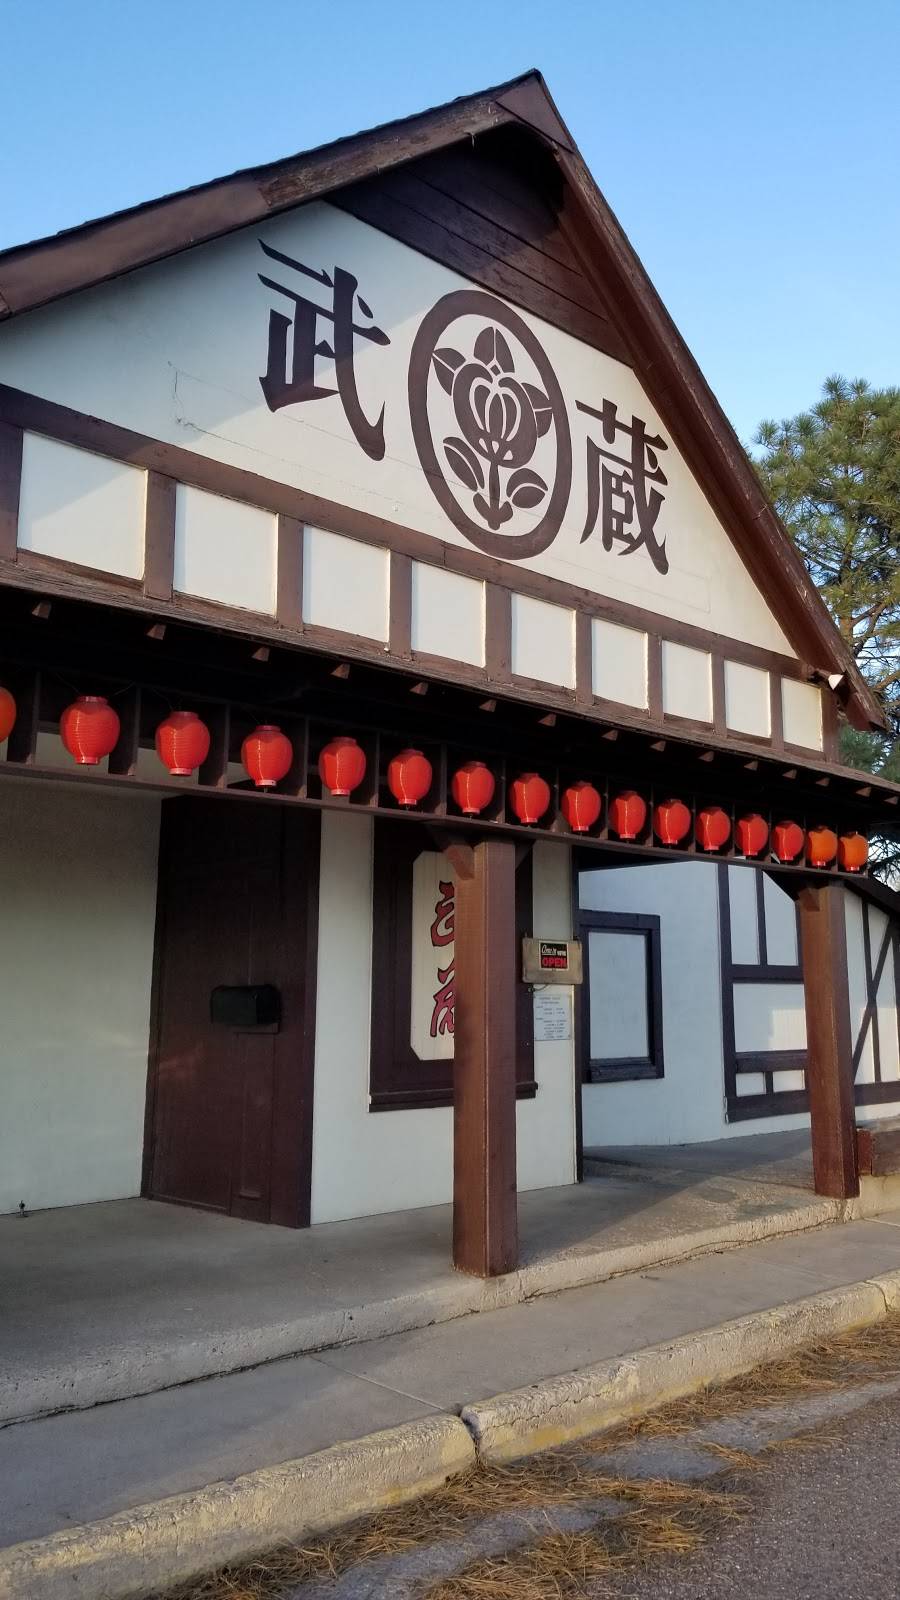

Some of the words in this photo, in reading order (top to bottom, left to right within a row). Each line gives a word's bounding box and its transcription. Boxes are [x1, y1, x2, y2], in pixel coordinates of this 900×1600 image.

[257, 239, 391, 462] 武
[575, 398, 670, 575] 蔵
[542, 956, 567, 966] OPEN
